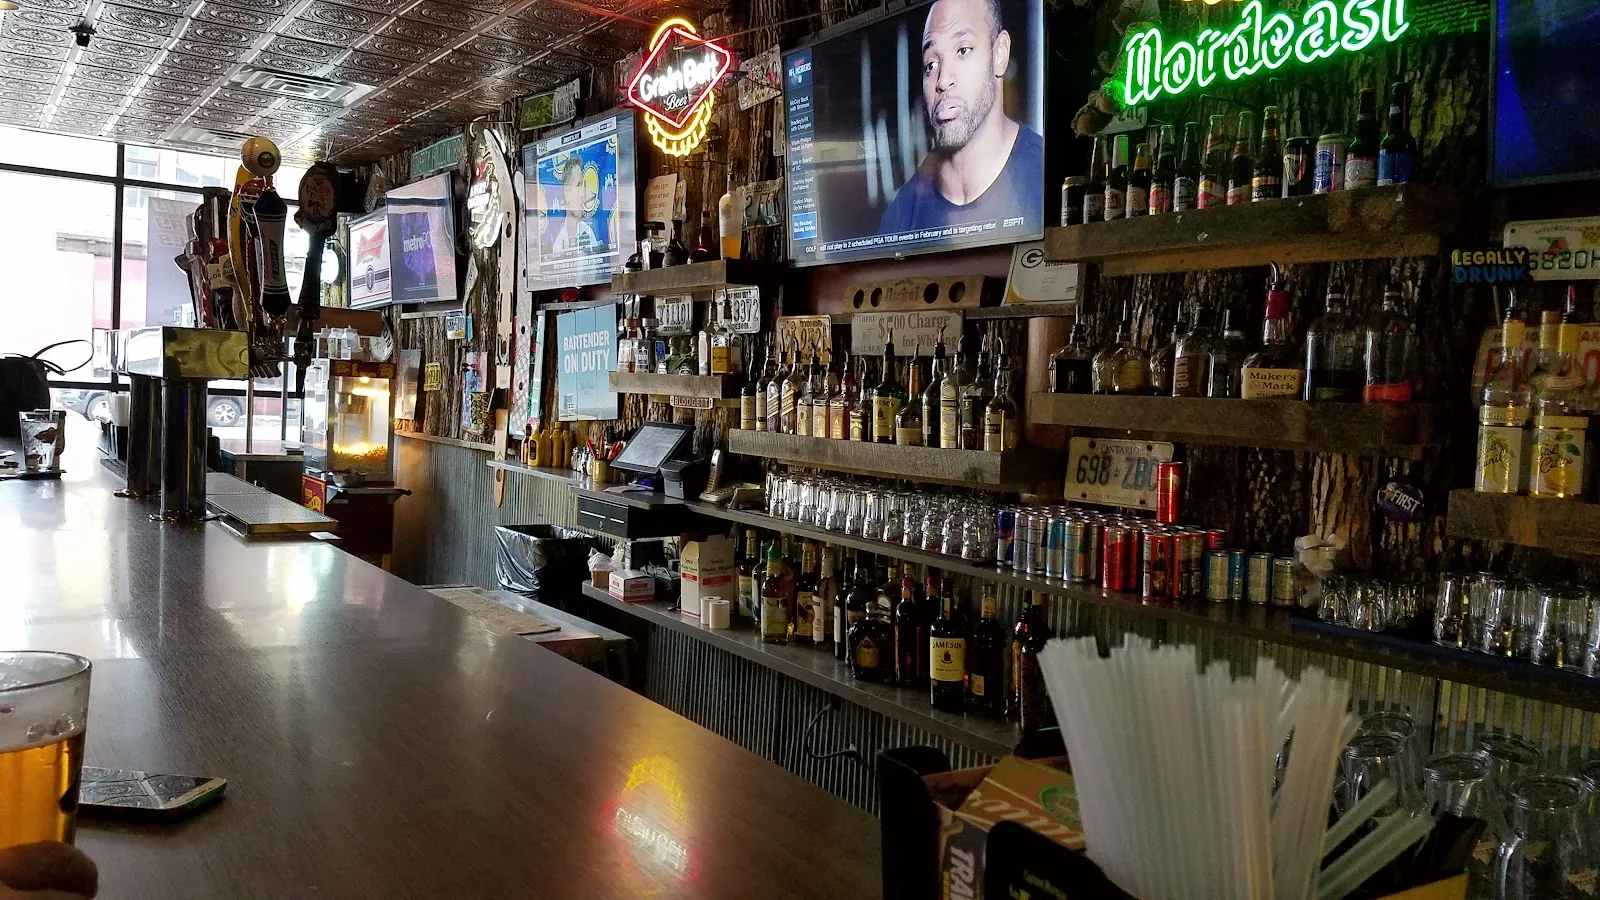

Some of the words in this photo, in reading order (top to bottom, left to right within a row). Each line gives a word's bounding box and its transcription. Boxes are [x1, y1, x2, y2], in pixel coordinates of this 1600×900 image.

[640, 65, 683, 101] Grain
[682, 51, 720, 89] Belt
[664, 94, 688, 111] Beer
[1003, 216, 1024, 228] ESPN
[852, 238, 873, 247] scheduled
[873, 236, 884, 244] PGA
[884, 234, 898, 243] TOUR
[898, 233, 914, 242] events
[920, 230, 942, 240] February
[942, 228, 952, 236] and
[959, 224, 982, 234] targeting
[1454, 250, 1526, 265] LEGALLY
[1454, 265, 1528, 283] DRUNK
[908, 312, 950, 330] Charge
[563, 330, 610, 352] BARTENDER
[902, 335, 915, 347] for
[564, 353, 578, 374] ON
[581, 348, 610, 372] DUTY
[1176, 358, 1188, 388] KNOB
[1250, 372, 1296, 381] Maker's
[1262, 381, 1294, 390] Mark
[674, 396, 710, 409] BLODGETT
[1100, 444, 1140, 455] ONTARIO
[1536, 442, 1560, 461] Stoli
[1076, 454, 1112, 486] 698
[1391, 490, 1420, 512] FIRST
[932, 641, 962, 650] JAMESON
